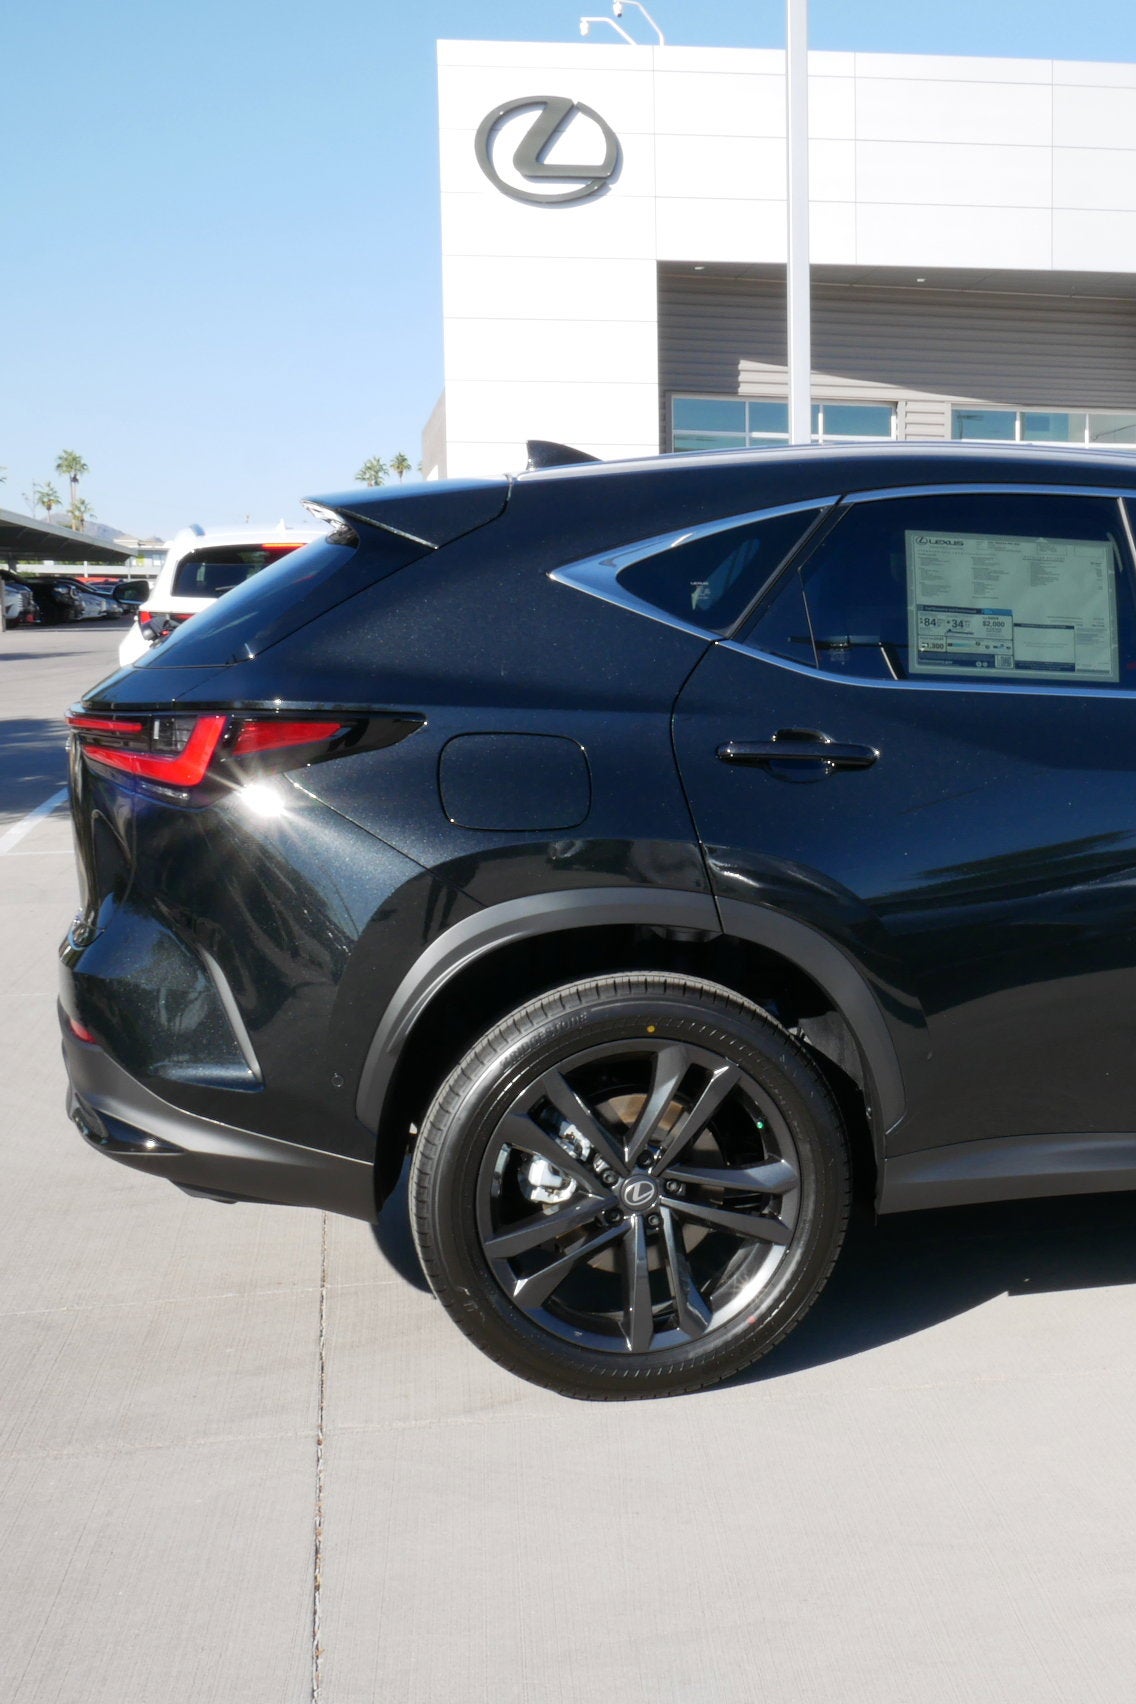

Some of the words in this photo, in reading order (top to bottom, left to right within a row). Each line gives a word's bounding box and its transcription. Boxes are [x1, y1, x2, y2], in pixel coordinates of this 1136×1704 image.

[928, 539, 964, 547] LEXUS
[923, 617, 937, 627] 84
[951, 619, 964, 629] 34
